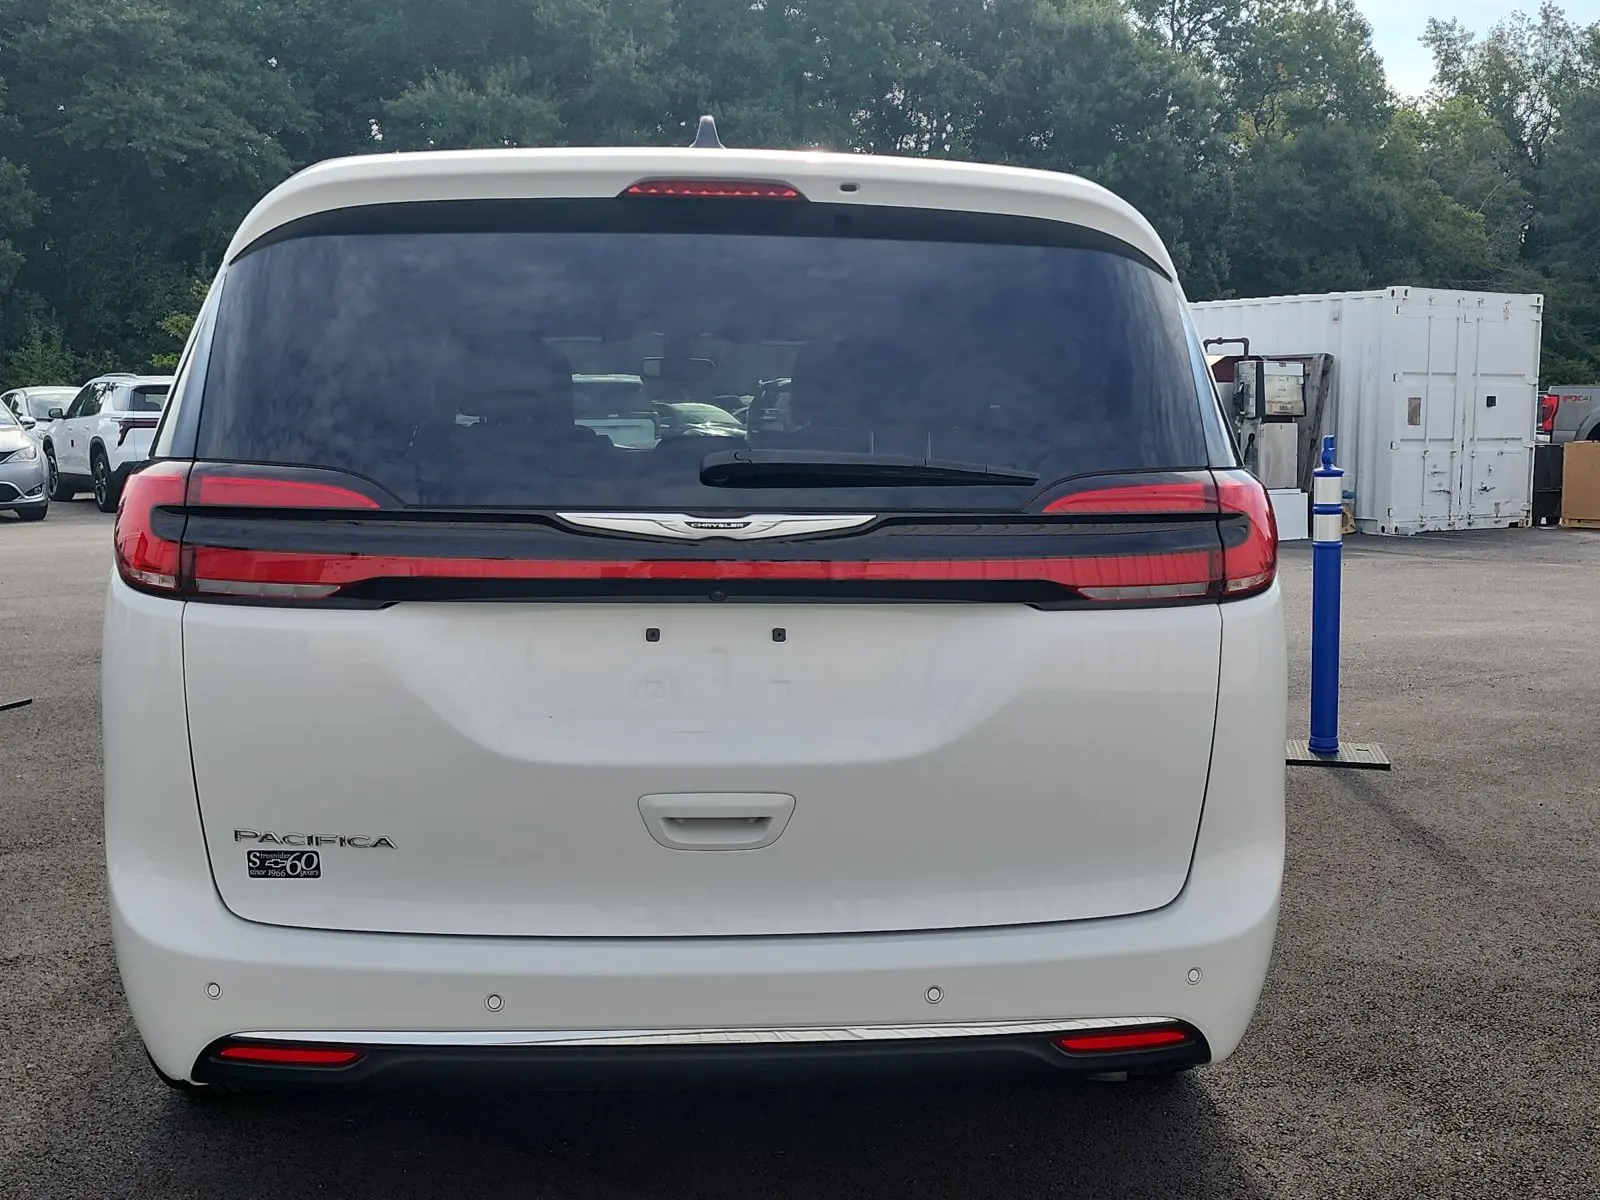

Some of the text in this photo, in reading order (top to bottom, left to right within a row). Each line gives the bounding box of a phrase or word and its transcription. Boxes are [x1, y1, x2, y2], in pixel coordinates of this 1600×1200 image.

[233, 828, 397, 849] PACIFICA
[286, 852, 318, 875] 60
[249, 868, 286, 877] since 1966
[299, 870, 319, 878] years
